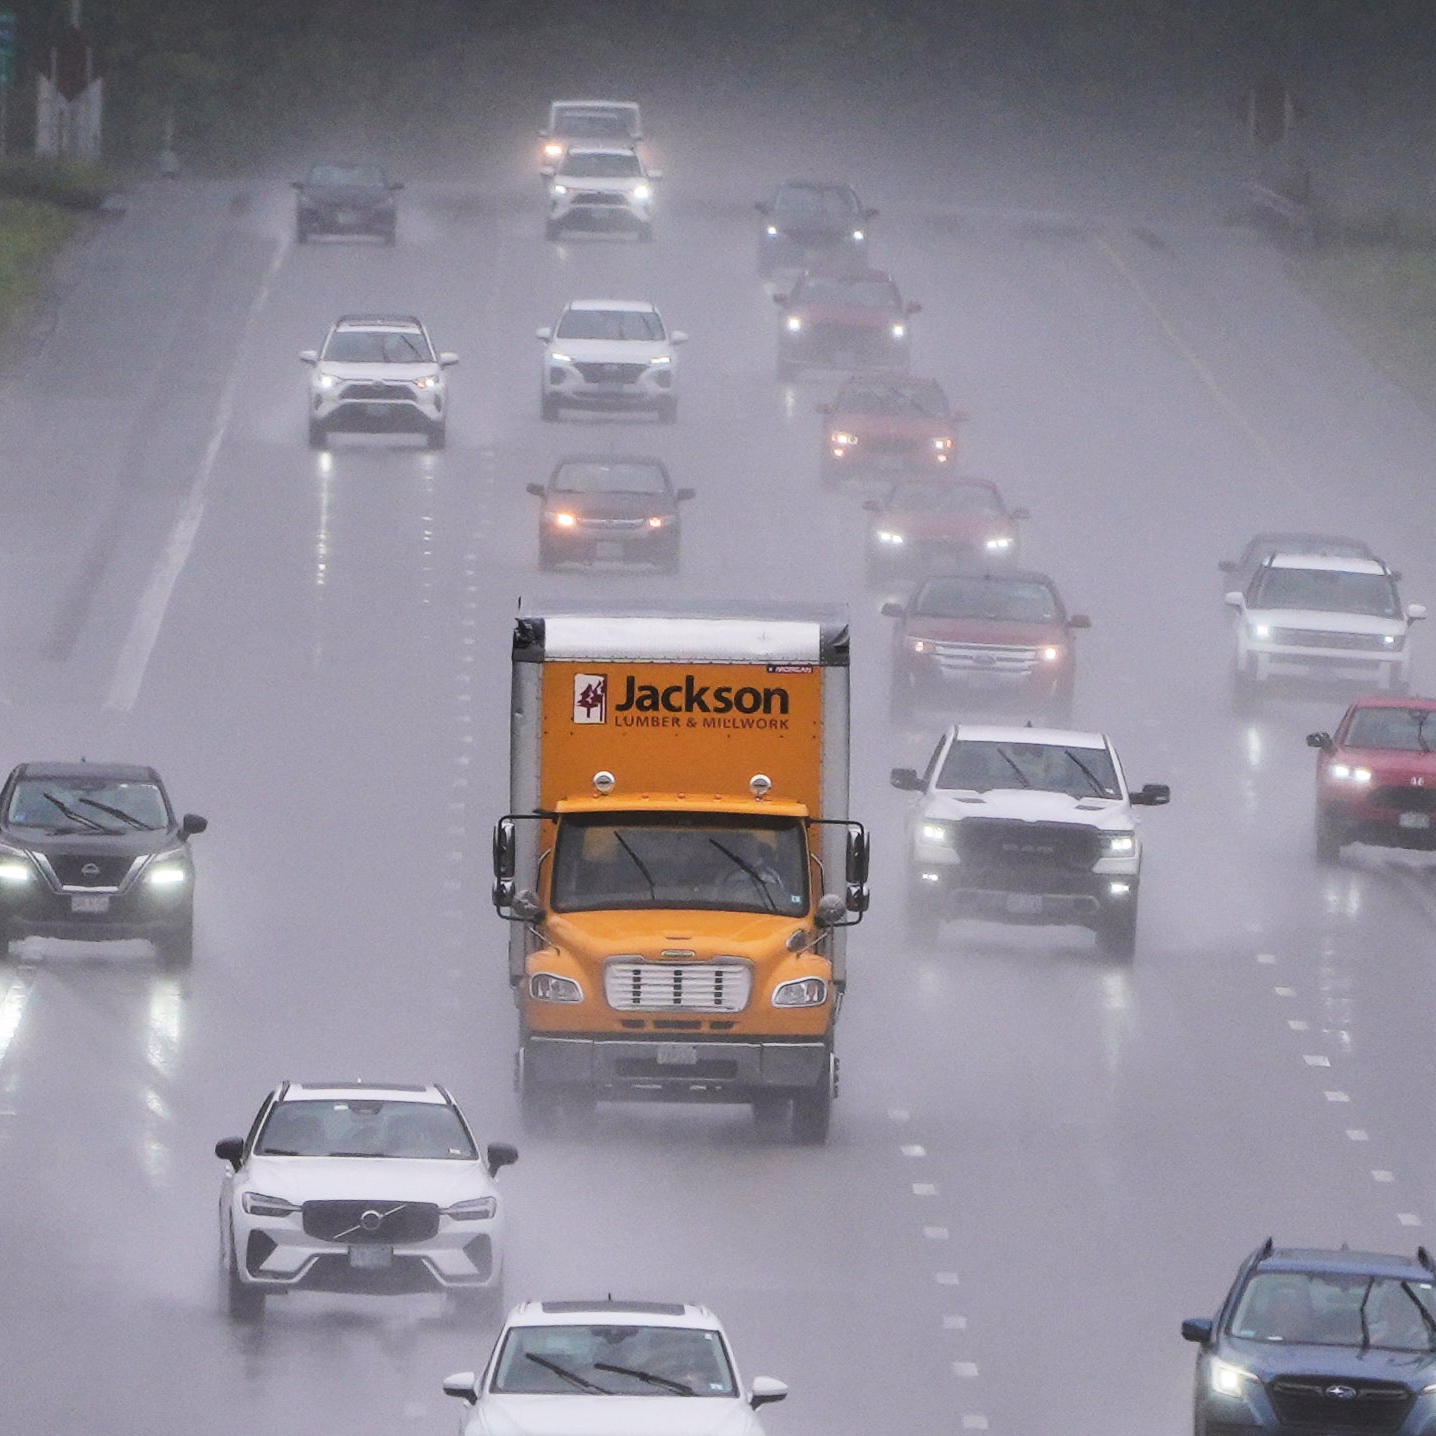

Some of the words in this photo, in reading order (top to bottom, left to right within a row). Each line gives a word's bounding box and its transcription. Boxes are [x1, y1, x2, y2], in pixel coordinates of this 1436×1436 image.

[615, 675, 790, 714] Jackson
[615, 716, 681, 728] LUMBER
[686, 717, 698, 728] &
[702, 718, 790, 730] MILLWORK
